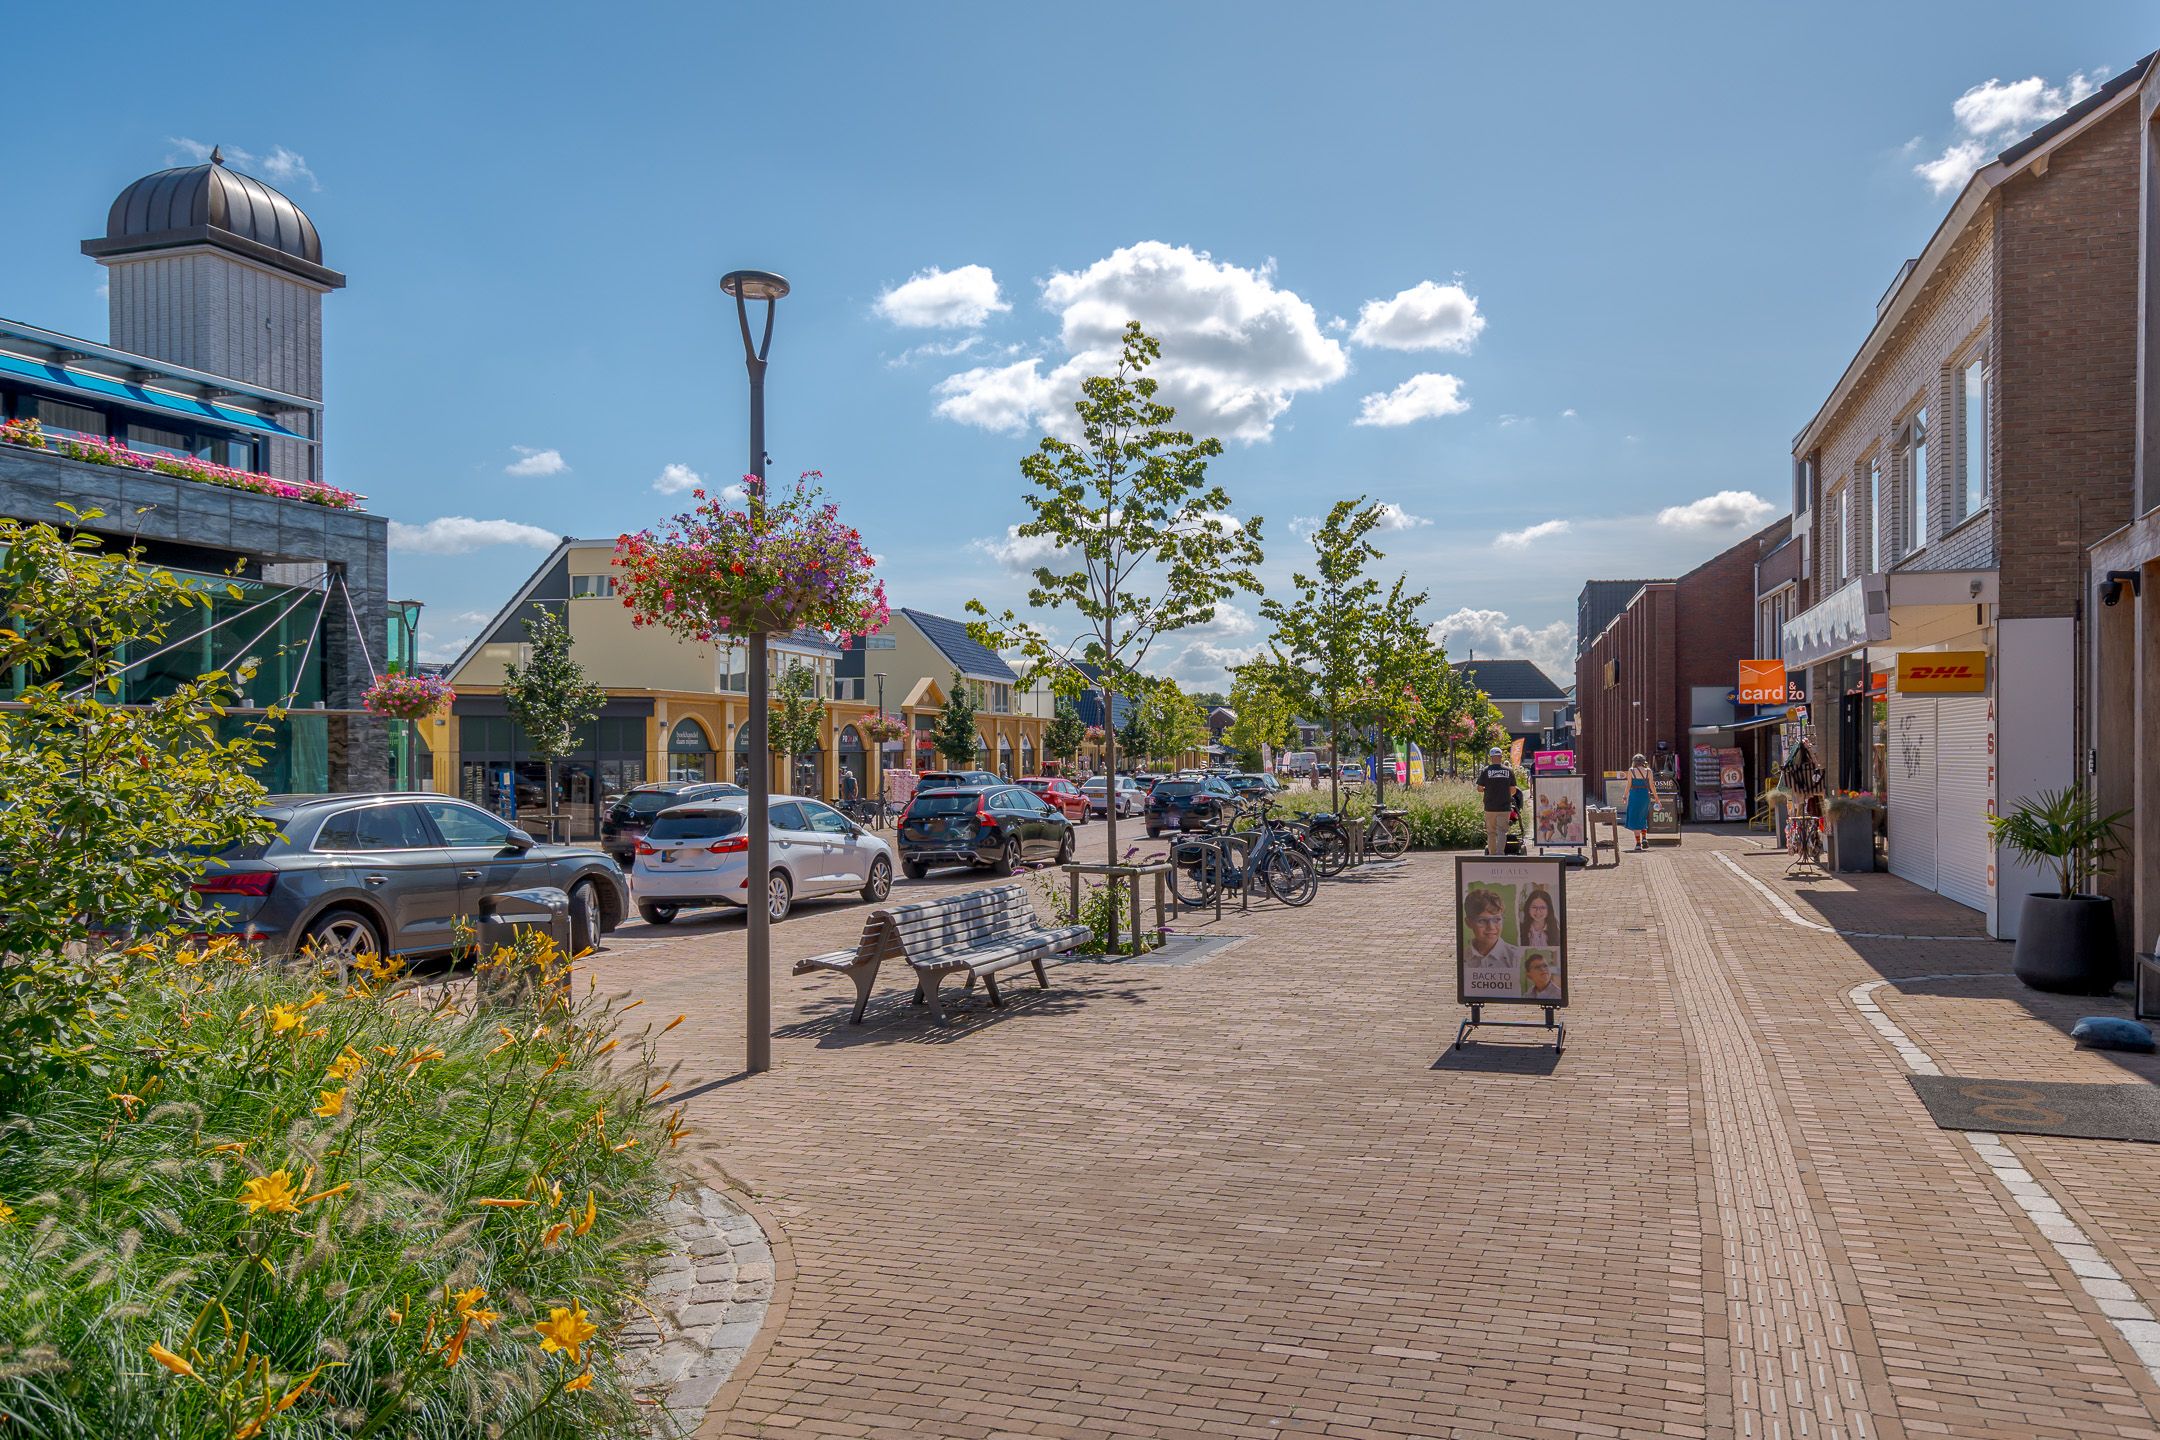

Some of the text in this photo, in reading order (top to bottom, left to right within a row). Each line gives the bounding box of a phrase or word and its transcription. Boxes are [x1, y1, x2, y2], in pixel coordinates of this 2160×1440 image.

[1910, 666, 1973, 679] DHL
[1788, 681, 1797, 690] &
[1741, 685, 1784, 700] card
[1788, 690, 1804, 700] zo
[1725, 772, 1737, 782] 16
[1728, 805, 1740, 814] 70
[1653, 812, 1673, 823] 50%
[1472, 972, 1512, 981] BACK TO
[1471, 981, 1513, 990] SCHOOL!
